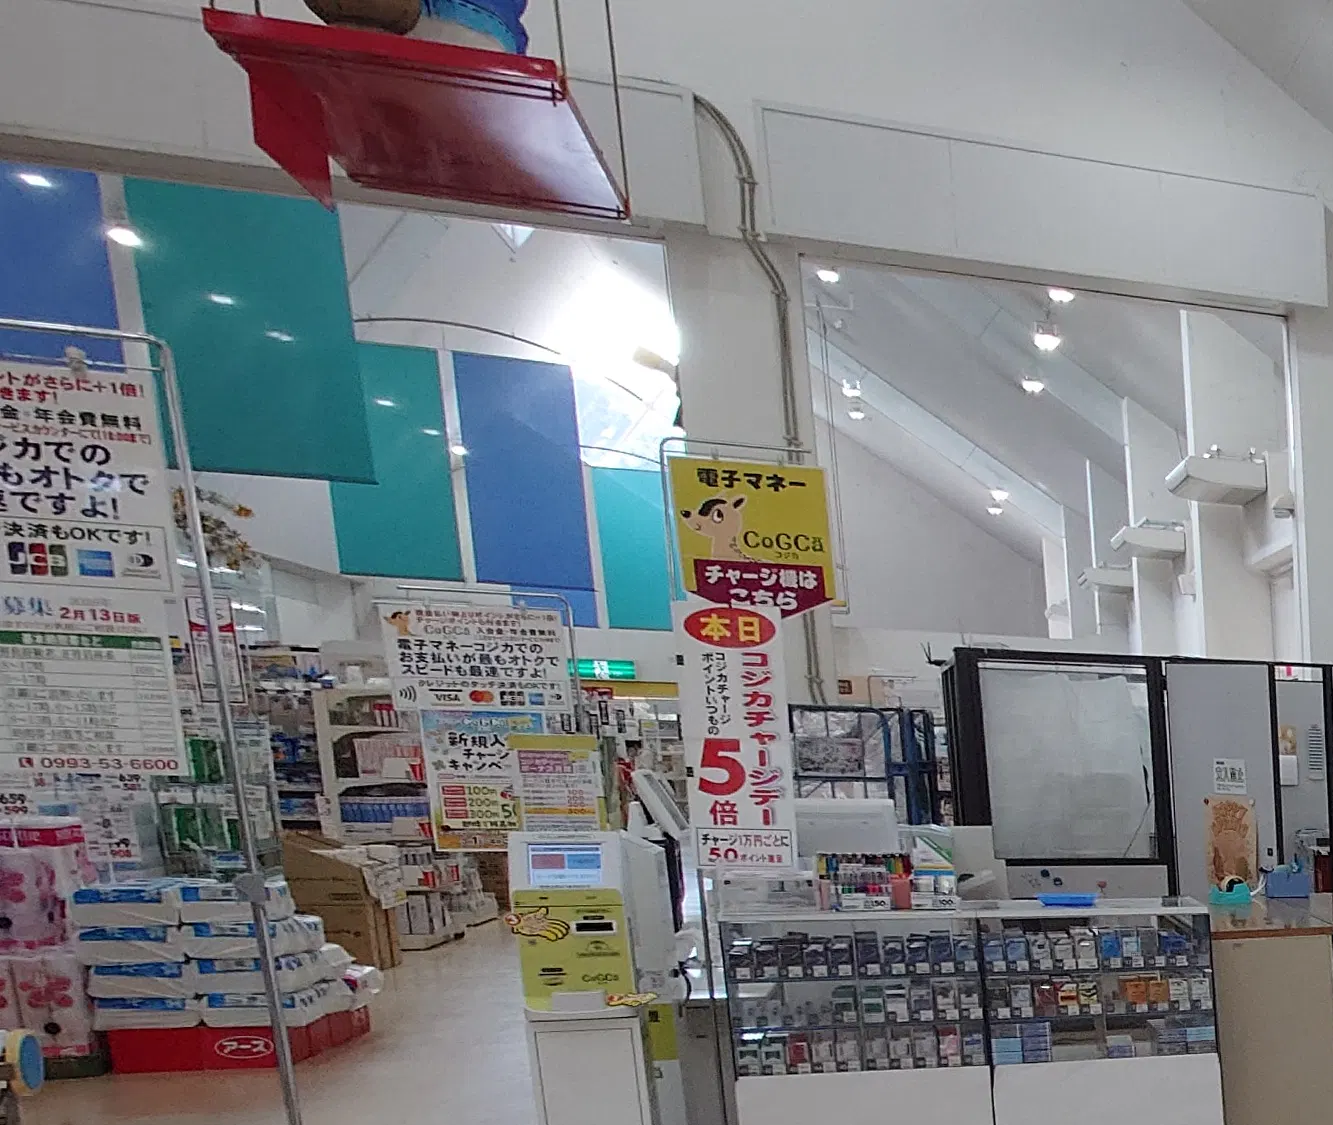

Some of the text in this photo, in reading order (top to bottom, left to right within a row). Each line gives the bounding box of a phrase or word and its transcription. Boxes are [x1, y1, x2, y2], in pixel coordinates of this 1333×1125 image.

[0, 437, 111, 466] カでの
[697, 468, 806, 492] 電子マネー
[0, 490, 119, 520] ですよ!
[705, 565, 818, 590] チャージ機は
[729, 588, 798, 610] こちら
[700, 613, 761, 642] 本日
[434, 694, 461, 702] VISA
[702, 653, 719, 735] ポイントいつもの
[715, 652, 731, 725] コジカチャージ
[740, 652, 780, 826] コジカチャージデー
[222, 1041, 267, 1054] アース
